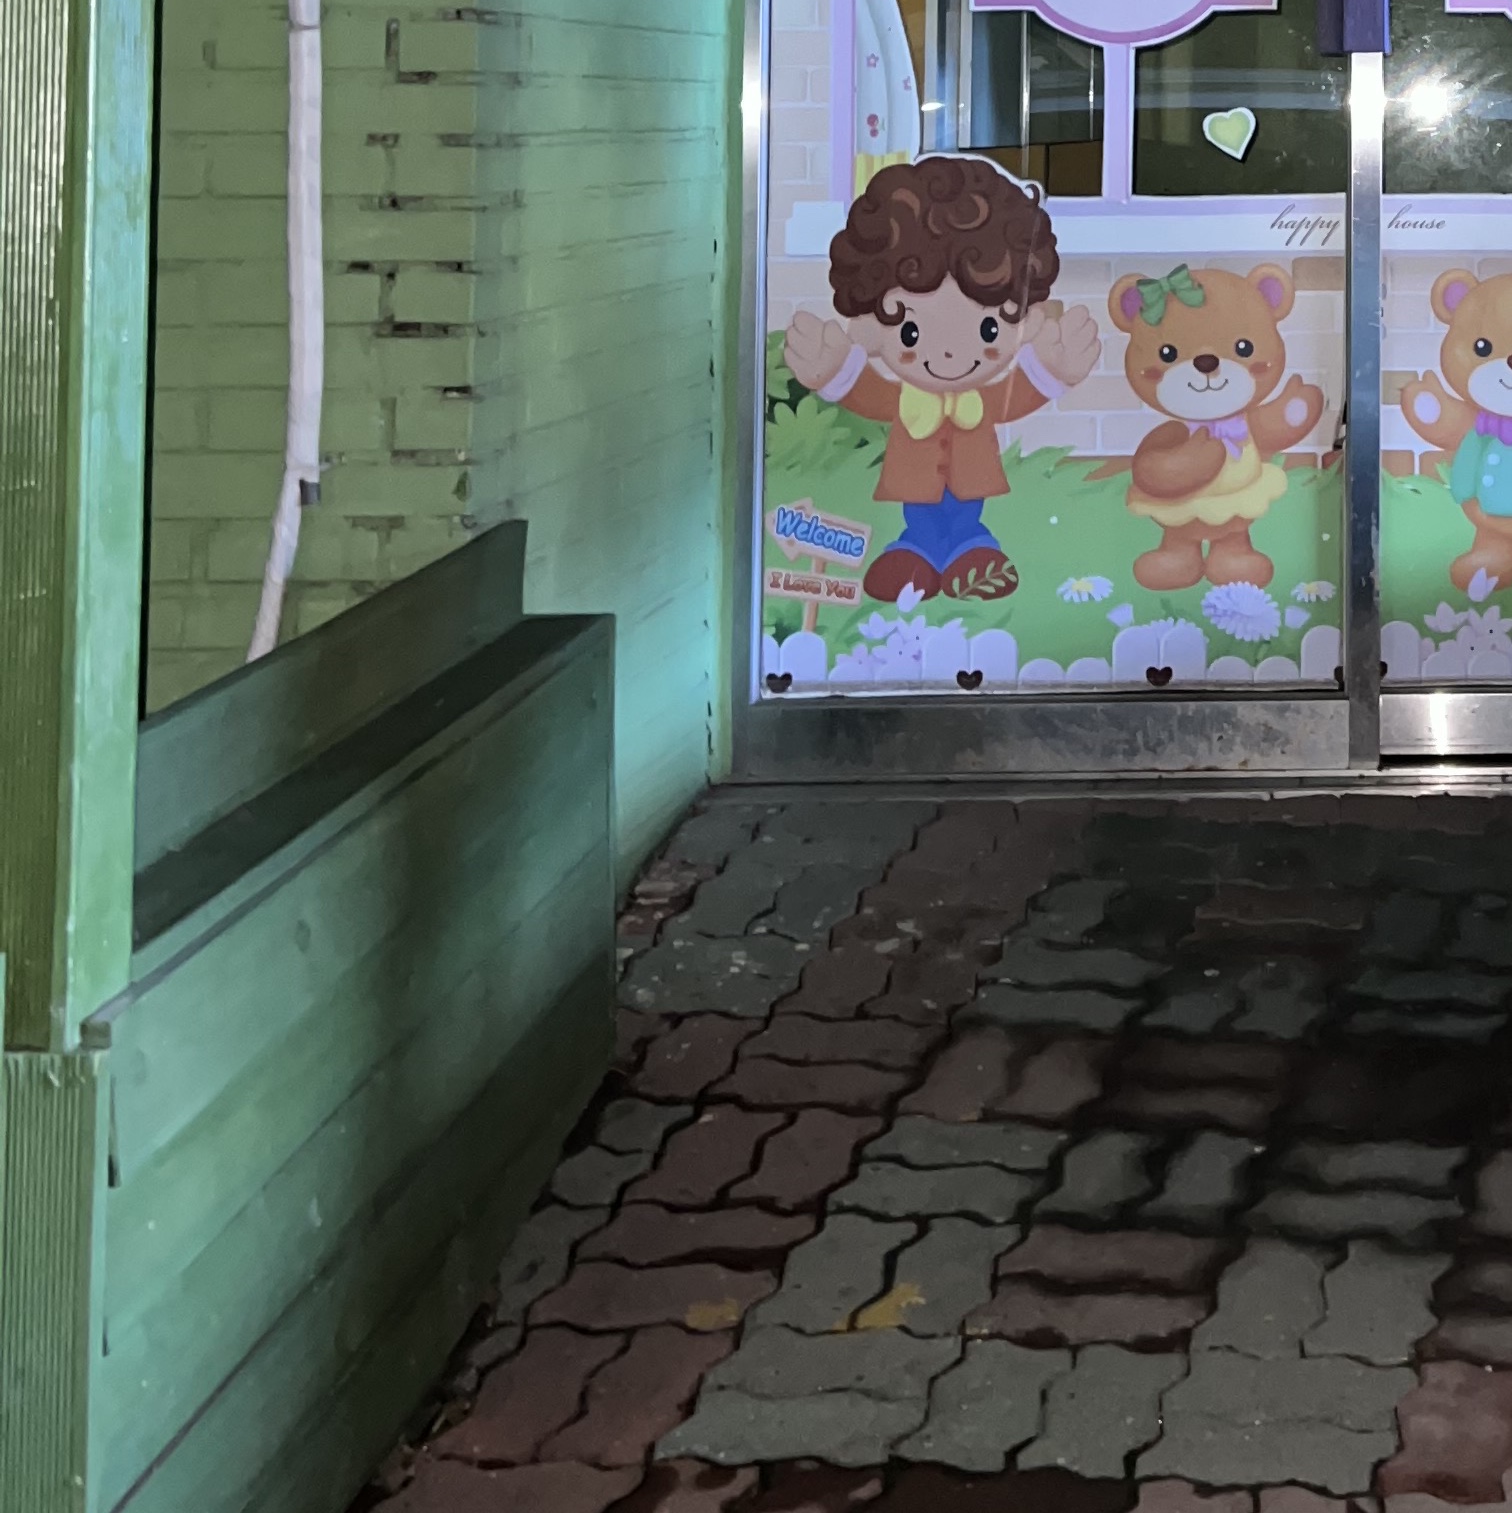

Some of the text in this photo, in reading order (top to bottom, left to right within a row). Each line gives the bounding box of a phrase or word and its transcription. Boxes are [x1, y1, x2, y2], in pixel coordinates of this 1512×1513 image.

[1269, 203, 1447, 247] happy house
[775, 506, 865, 558] Welcome
[769, 571, 856, 600] I Love You
